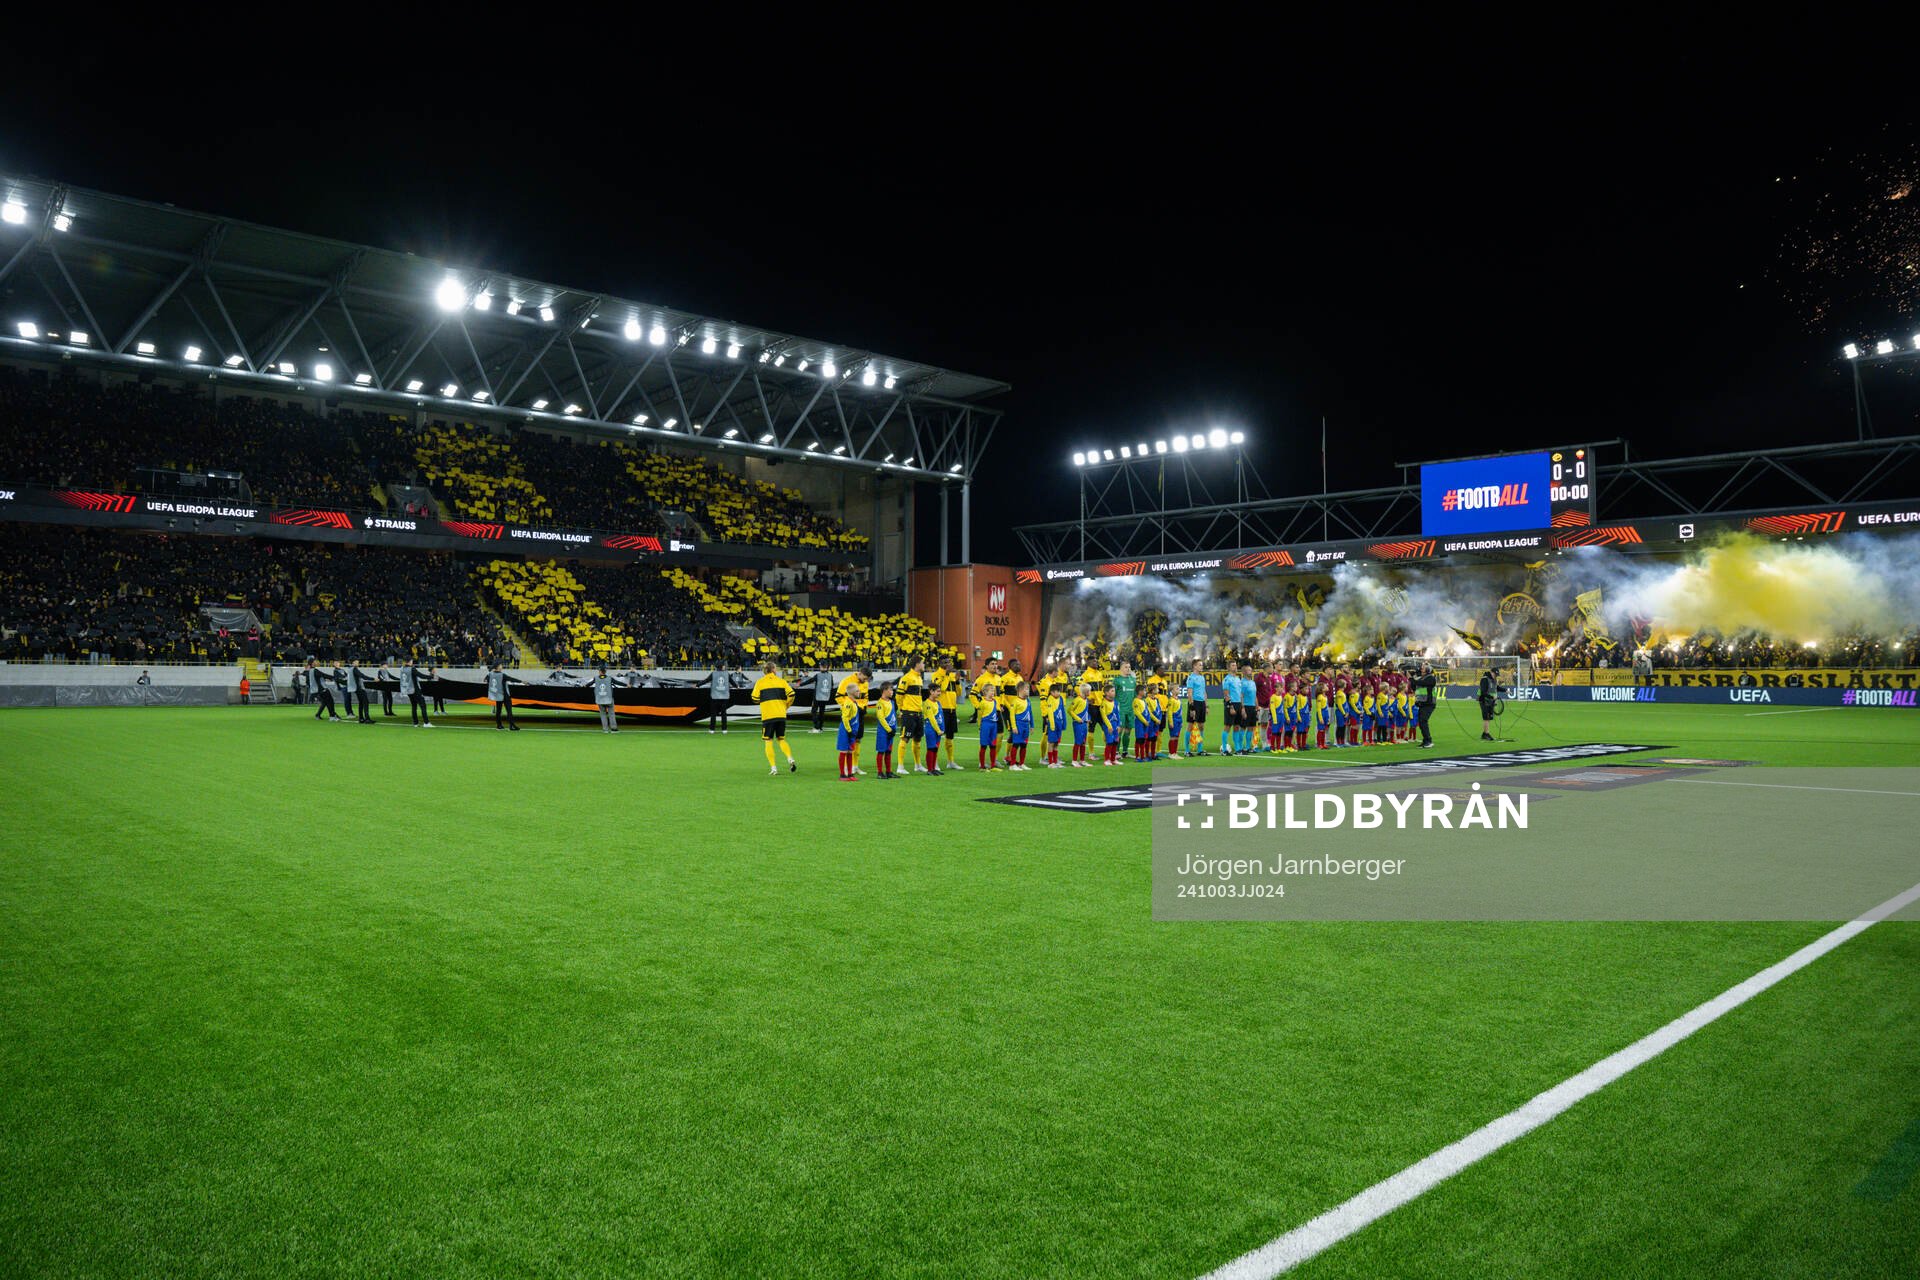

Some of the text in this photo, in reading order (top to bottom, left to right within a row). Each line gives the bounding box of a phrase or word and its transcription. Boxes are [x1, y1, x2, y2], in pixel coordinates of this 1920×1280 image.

[1553, 463, 1562, 481] 0
[1575, 461, 1585, 479] 0
[1441, 482, 1529, 512] #FOOTBALL
[146, 501, 255, 518] UEFA EUROPA LEAGUE
[374, 519, 417, 530] STRAUSS
[1858, 514, 1892, 525] UEFA
[511, 529, 590, 543] UEFA EUROPA LEAGUE
[1444, 537, 1539, 551] UEFA EUROPA LEAGUE
[1316, 551, 1346, 561] JUST EAT
[1151, 559, 1220, 571] UEFA EUROPA LEAGUE
[1644, 669, 1920, 688] ELFSBORGSLÄKT
[1507, 687, 1541, 699] UEFA
[1591, 686, 1656, 701] WELCOME ALL
[1729, 689, 1771, 702] UEFA
[1842, 689, 1917, 705] #FOOTBALL
